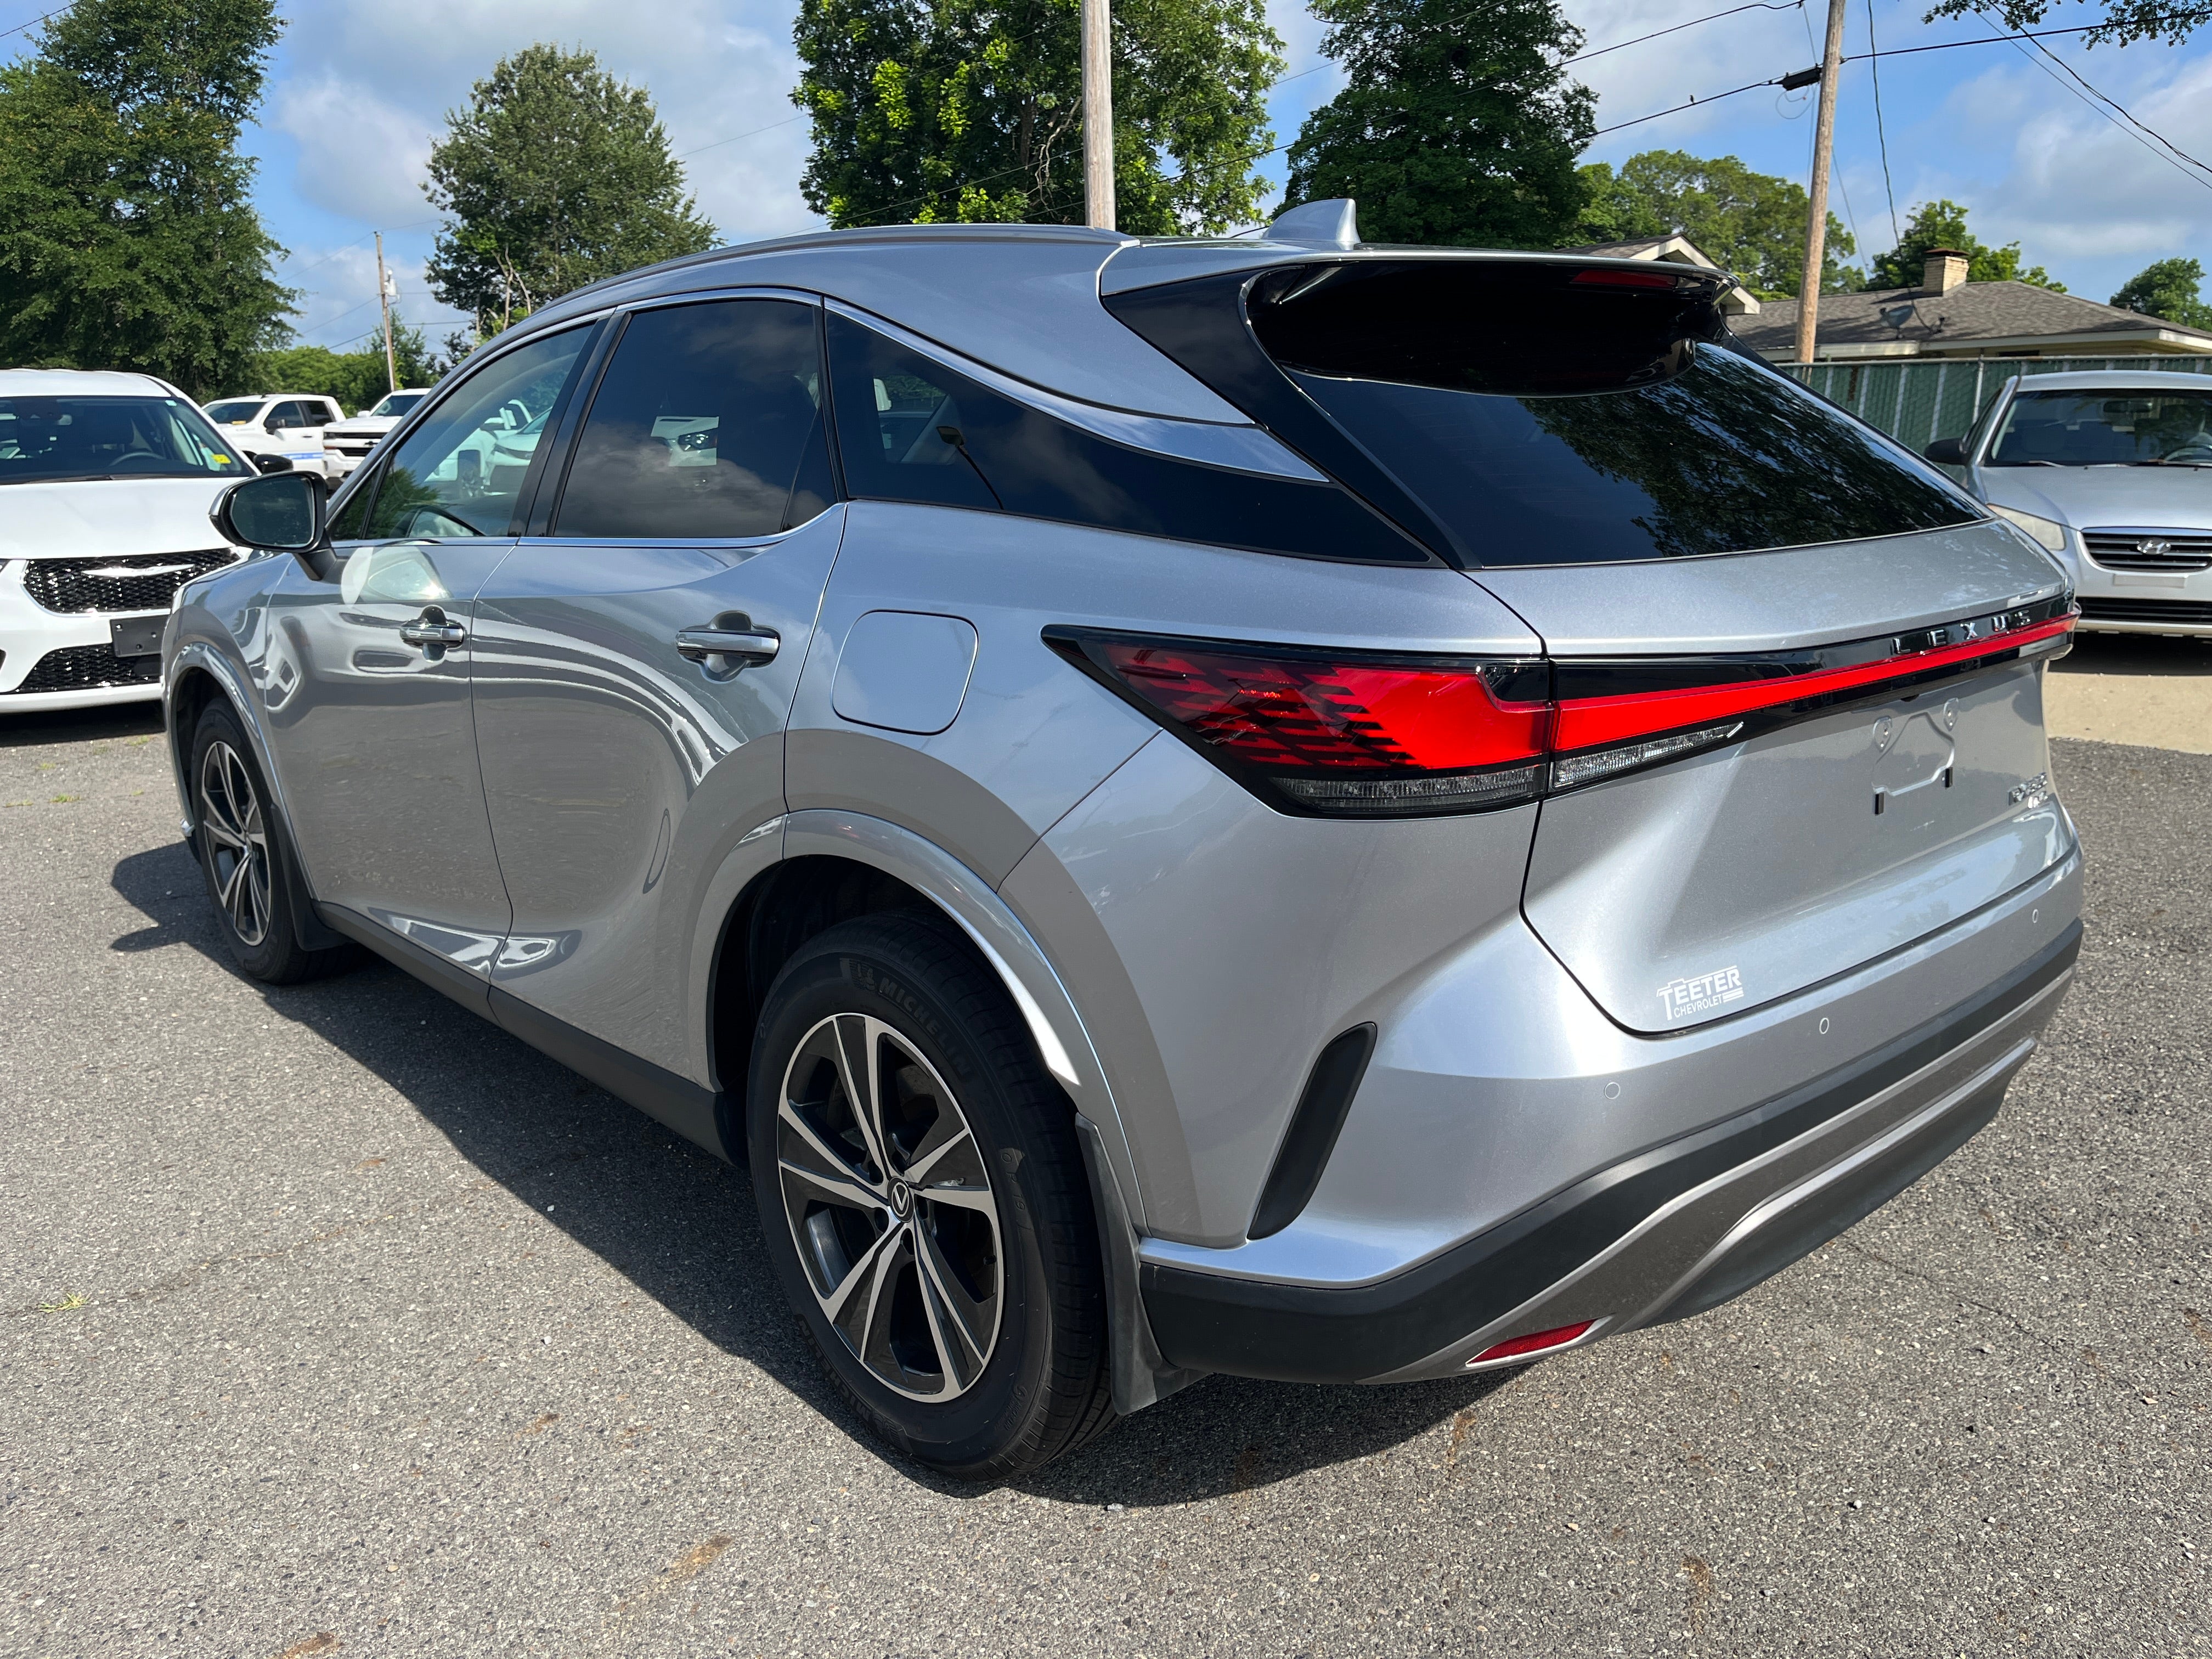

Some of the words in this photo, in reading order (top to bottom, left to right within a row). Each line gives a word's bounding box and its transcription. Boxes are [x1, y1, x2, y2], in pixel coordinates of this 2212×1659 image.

[1892, 610, 2030, 654] LEXUS
[1658, 968, 1742, 1021] TEETER
[1673, 994, 1723, 1018] CHEVROLET
[879, 977, 972, 1077] MICHELIN
[797, 1319, 872, 1421] MICHELIN
